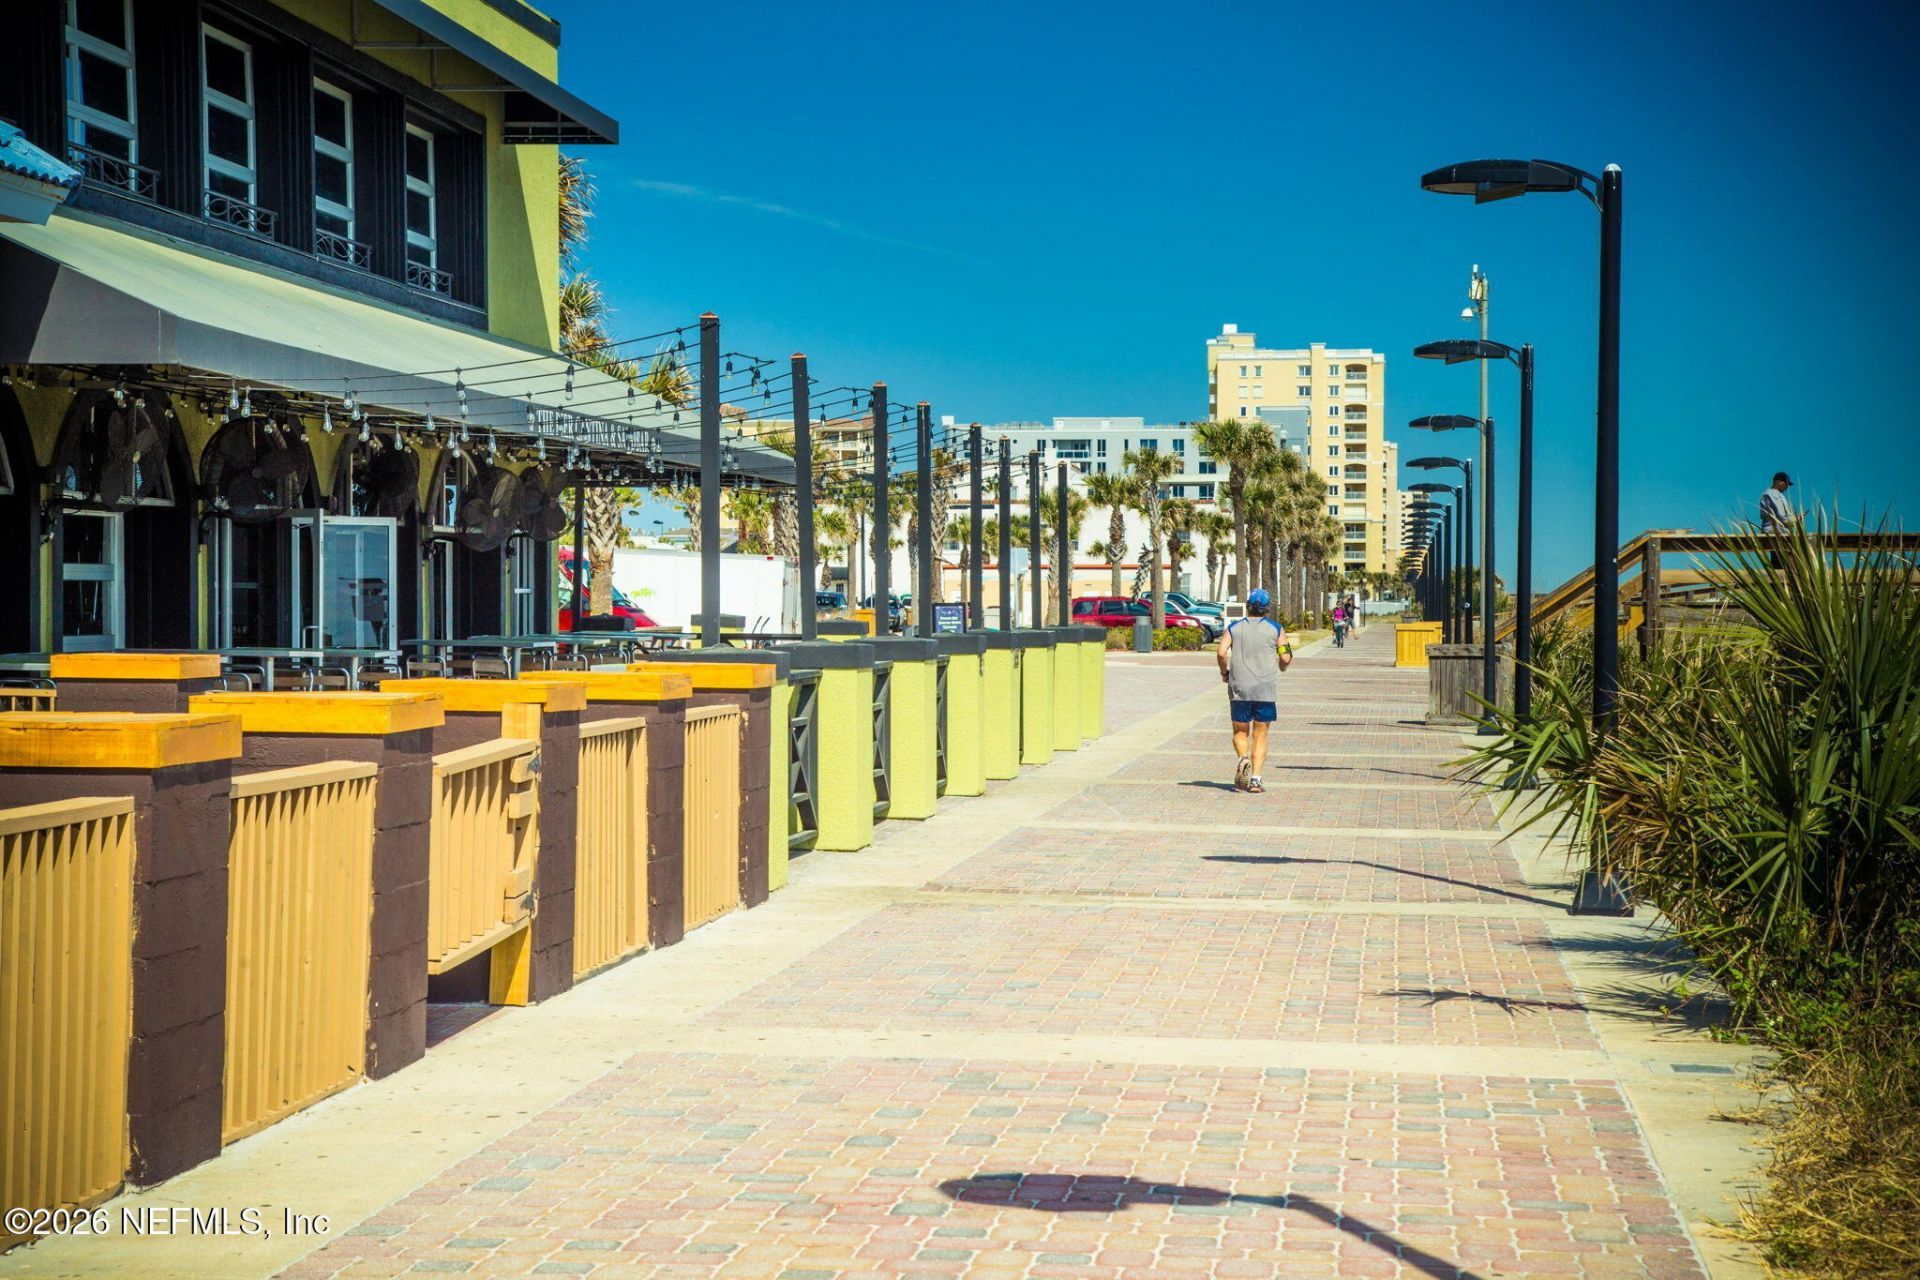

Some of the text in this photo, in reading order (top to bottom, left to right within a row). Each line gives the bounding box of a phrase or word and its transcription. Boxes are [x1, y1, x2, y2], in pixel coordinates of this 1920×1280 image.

[535, 409, 554, 436] THE
[574, 416, 609, 446] CANTINA
[610, 423, 616, 448] &
[617, 424, 650, 453] SABAR
